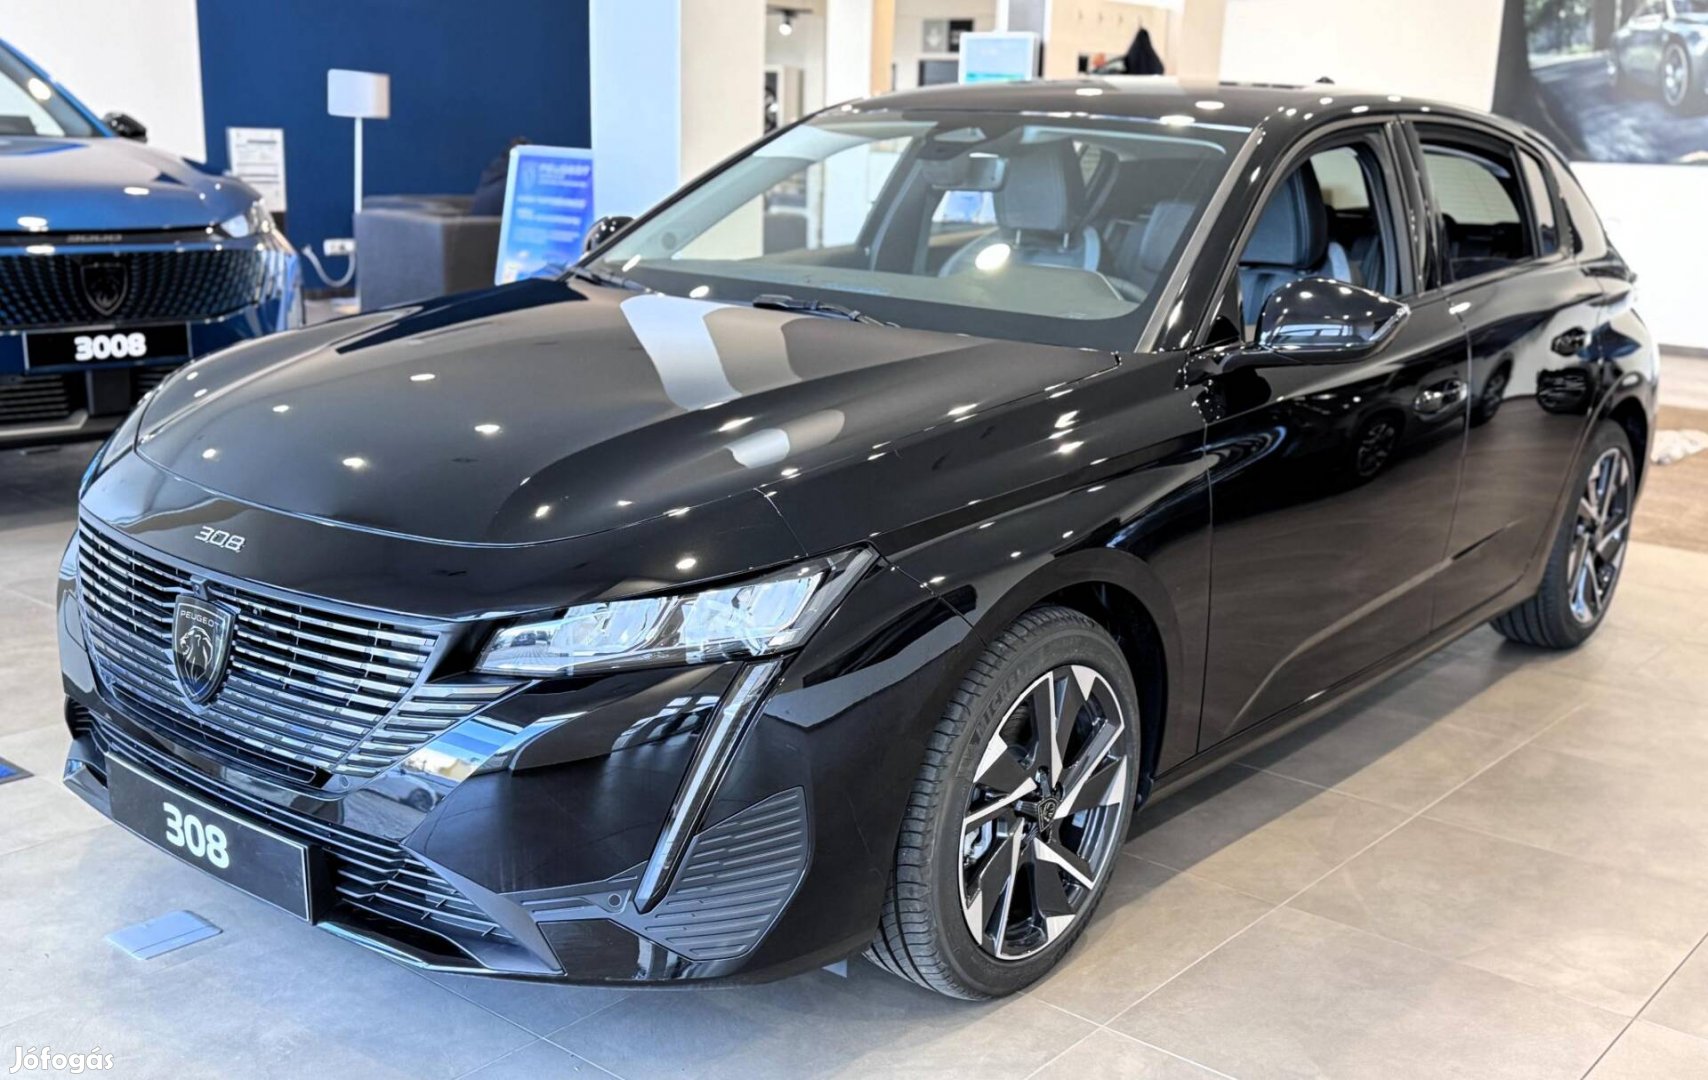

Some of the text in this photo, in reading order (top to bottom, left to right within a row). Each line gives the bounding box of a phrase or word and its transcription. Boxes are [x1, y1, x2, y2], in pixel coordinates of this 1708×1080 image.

[74, 332, 147, 361] 3008
[194, 525, 245, 552] 308
[180, 610, 219, 628] PEUGEOT
[163, 802, 229, 868] 308
